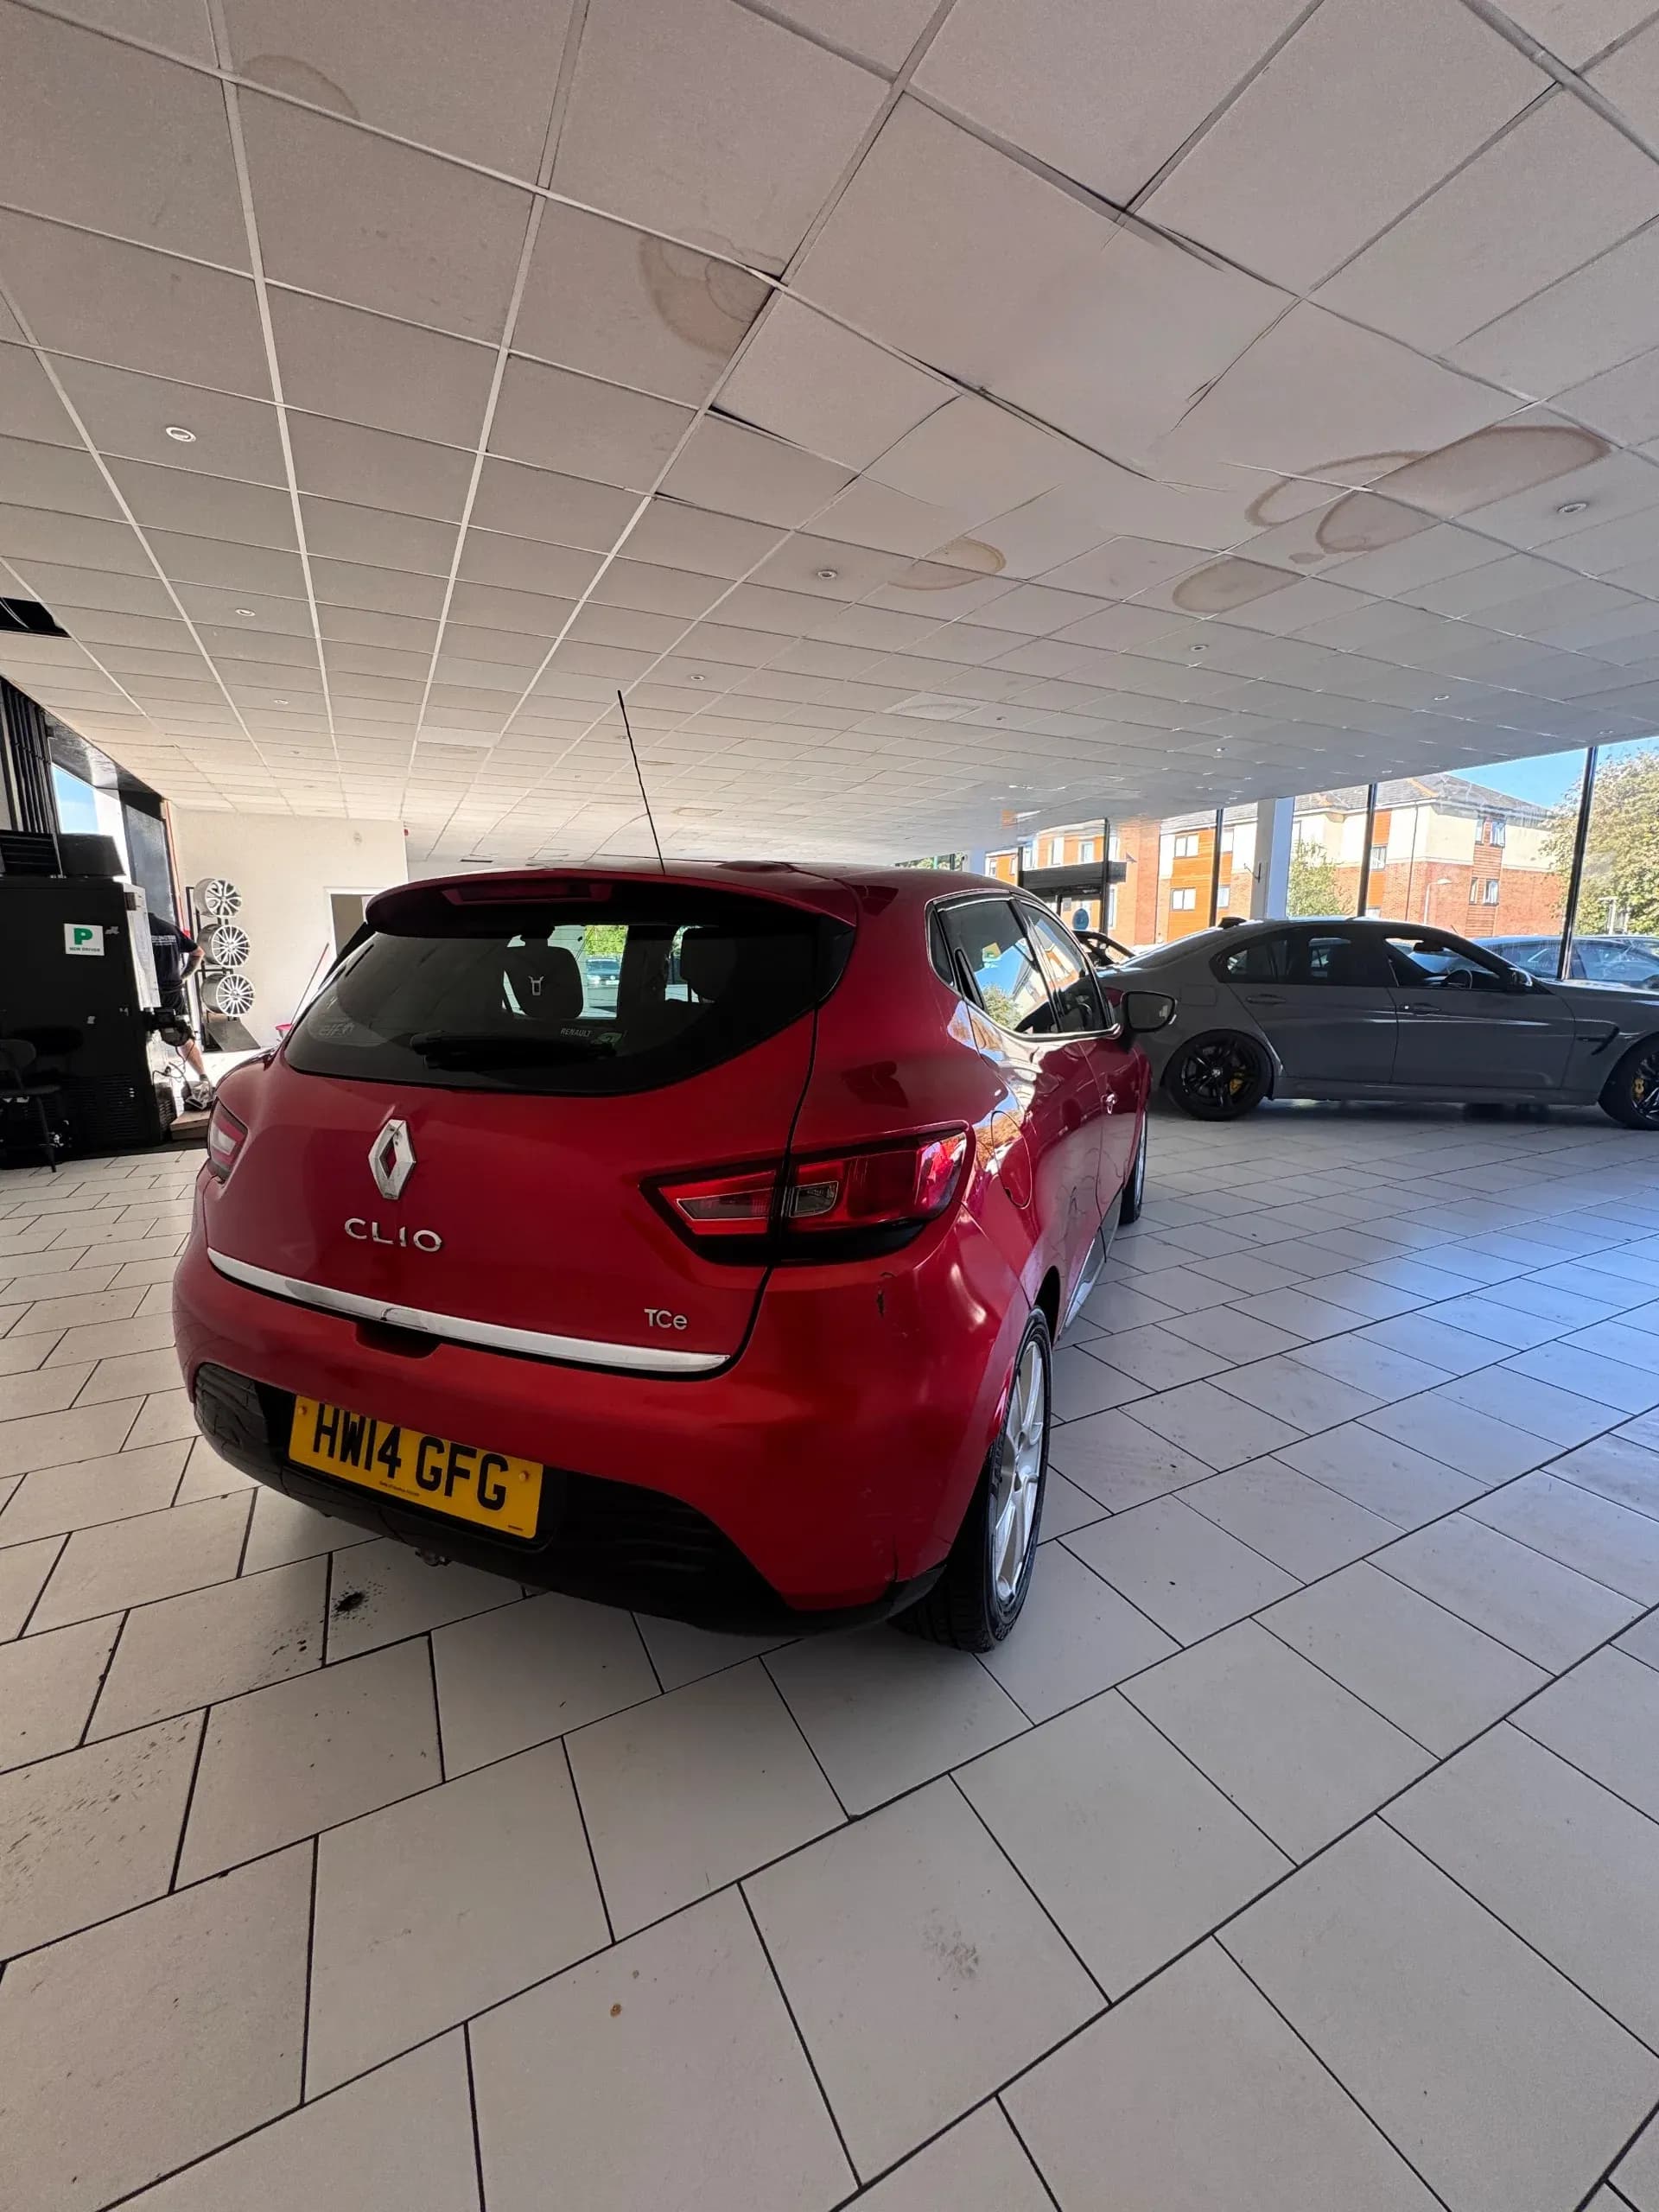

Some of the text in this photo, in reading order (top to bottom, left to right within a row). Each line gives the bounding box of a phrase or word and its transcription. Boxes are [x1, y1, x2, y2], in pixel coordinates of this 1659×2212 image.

[73, 927, 93, 945] P
[560, 1027, 592, 1038] RENAULT
[345, 1217, 442, 1252] CLIO
[644, 1308, 688, 1331] TCe
[313, 1402, 509, 1511] HW14 GFG
